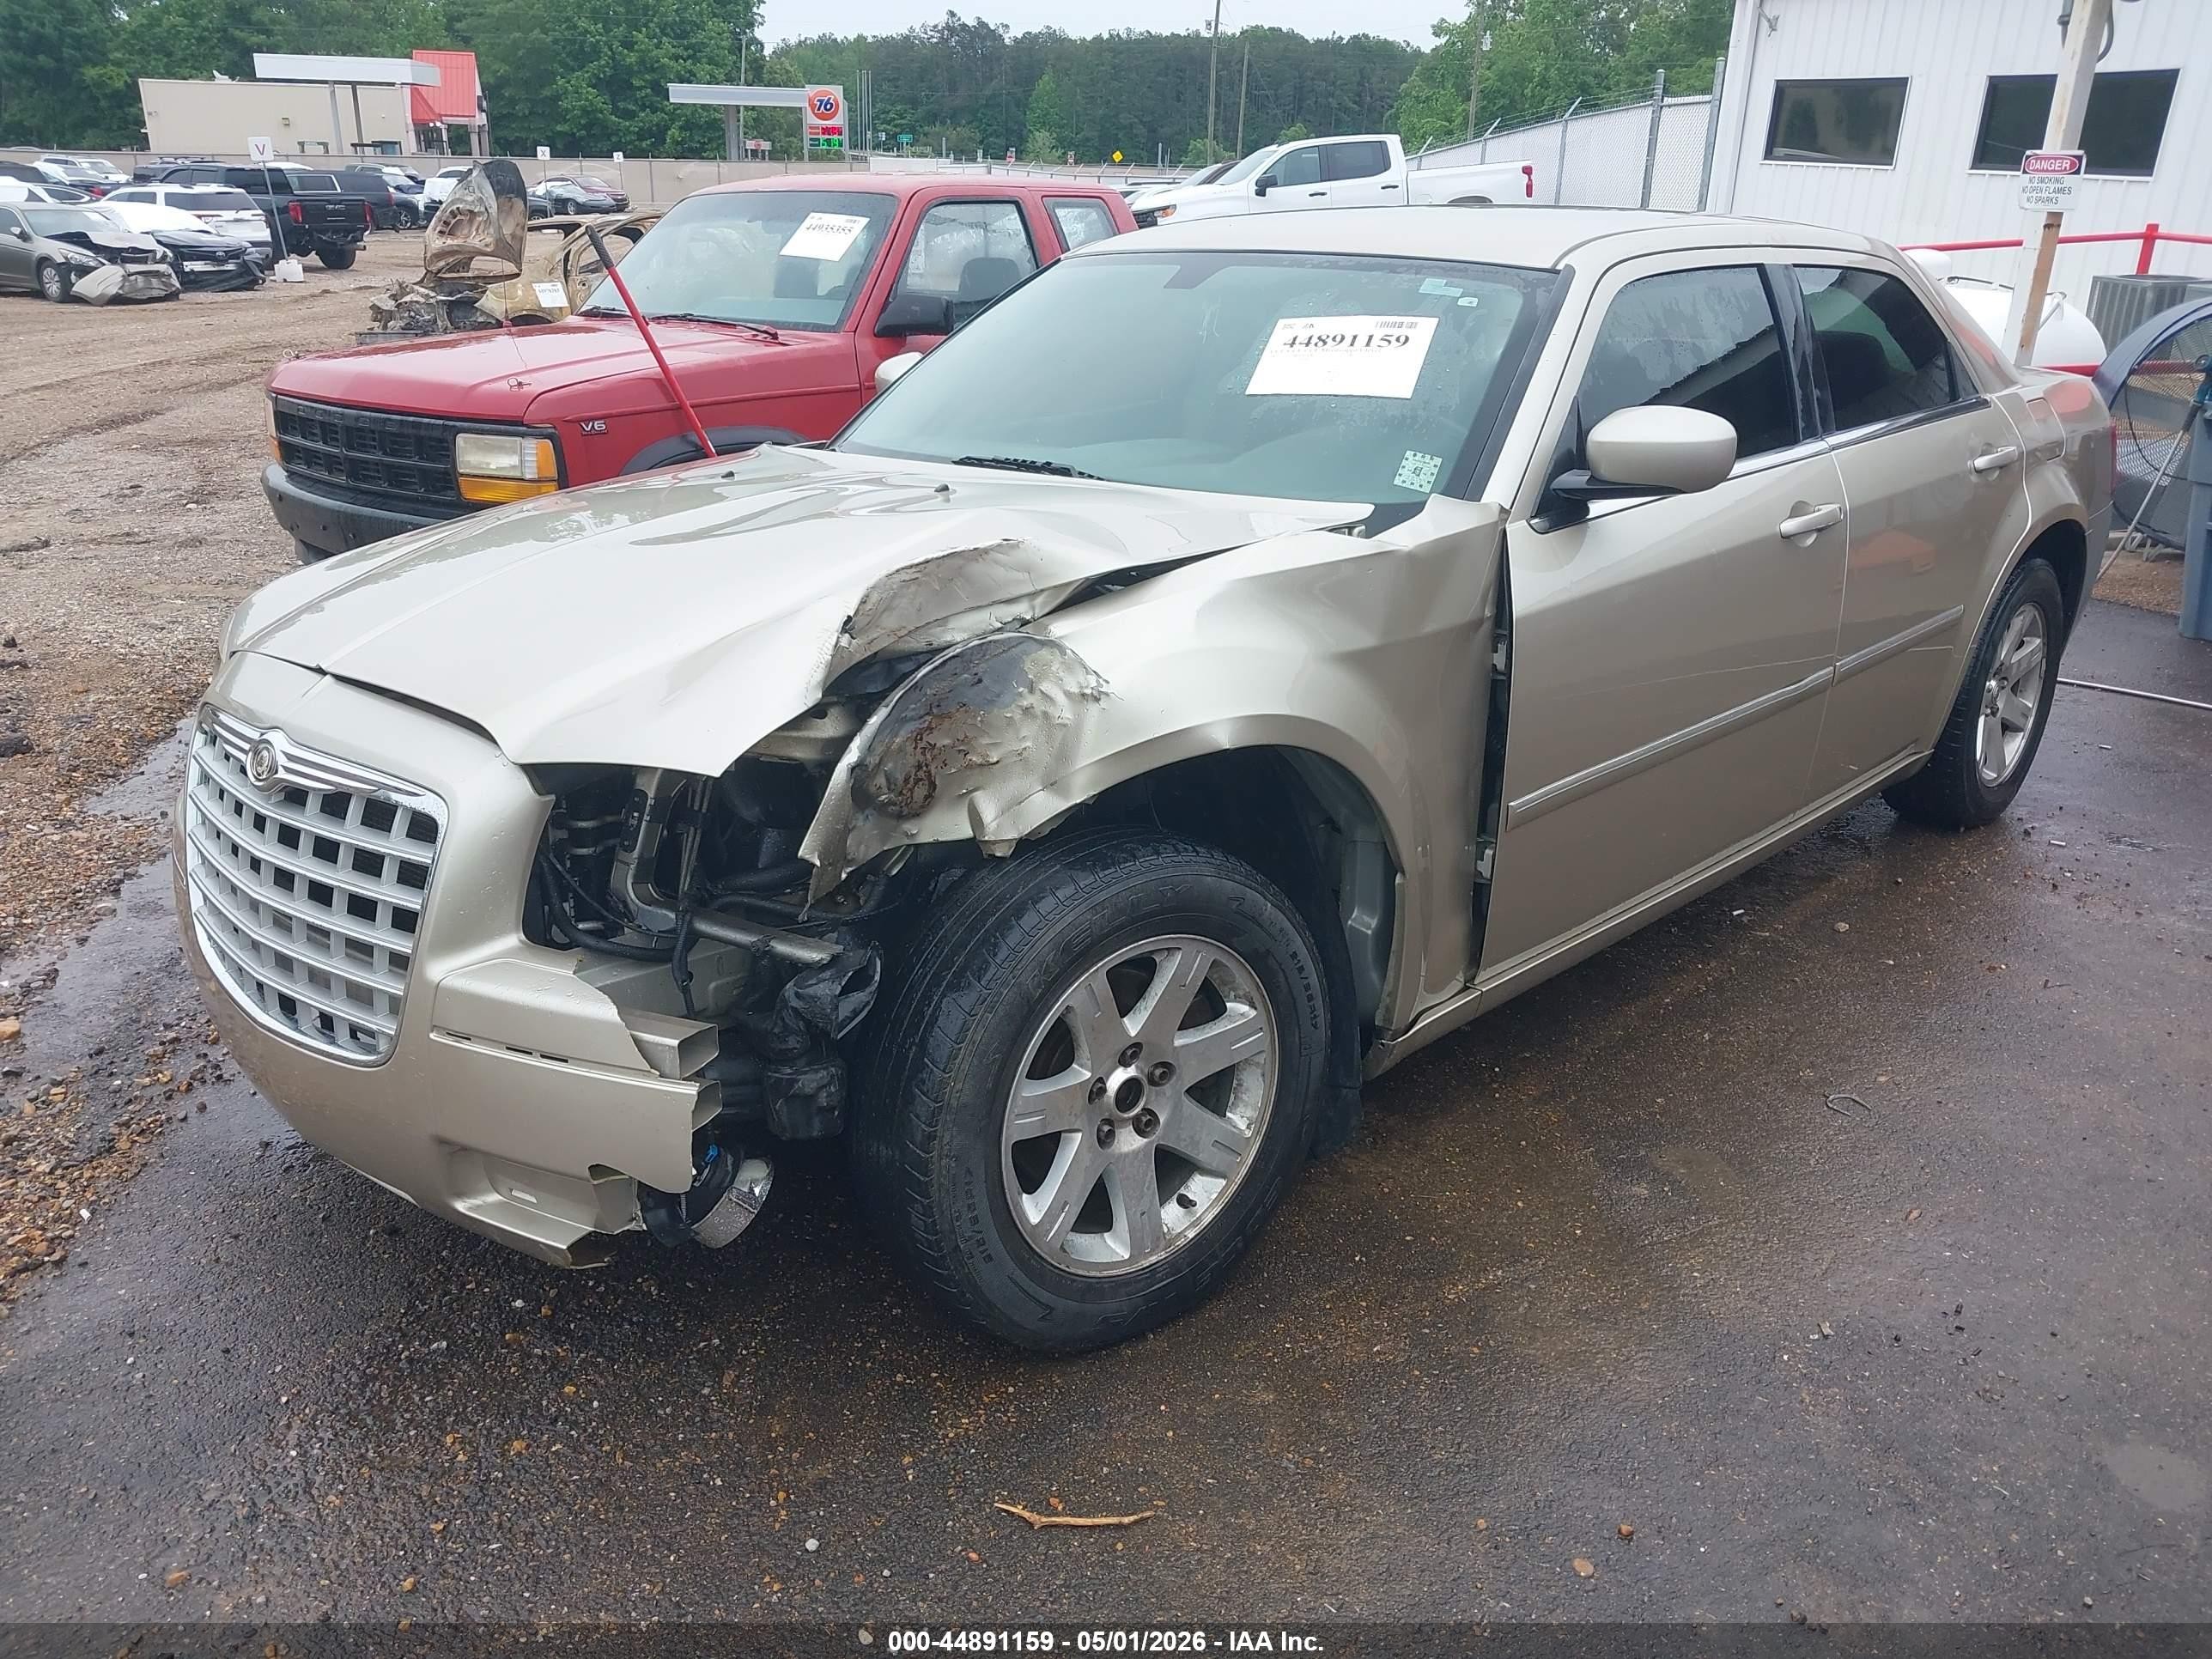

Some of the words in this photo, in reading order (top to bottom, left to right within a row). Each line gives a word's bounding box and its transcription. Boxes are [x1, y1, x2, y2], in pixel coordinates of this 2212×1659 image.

[815, 96, 835, 112] 76
[254, 143, 266, 155] V
[2029, 159, 2071, 170] DANGER
[2028, 176, 2036, 185] NO
[2036, 176, 2065, 185] SMOKING
[2021, 185, 2028, 194] NO
[2028, 186, 2043, 195] OPEN
[2044, 186, 2072, 195] FLAMES
[2034, 196, 2059, 204] SPARKS
[1283, 333, 1410, 349] 44891159
[580, 421, 606, 431] V6
